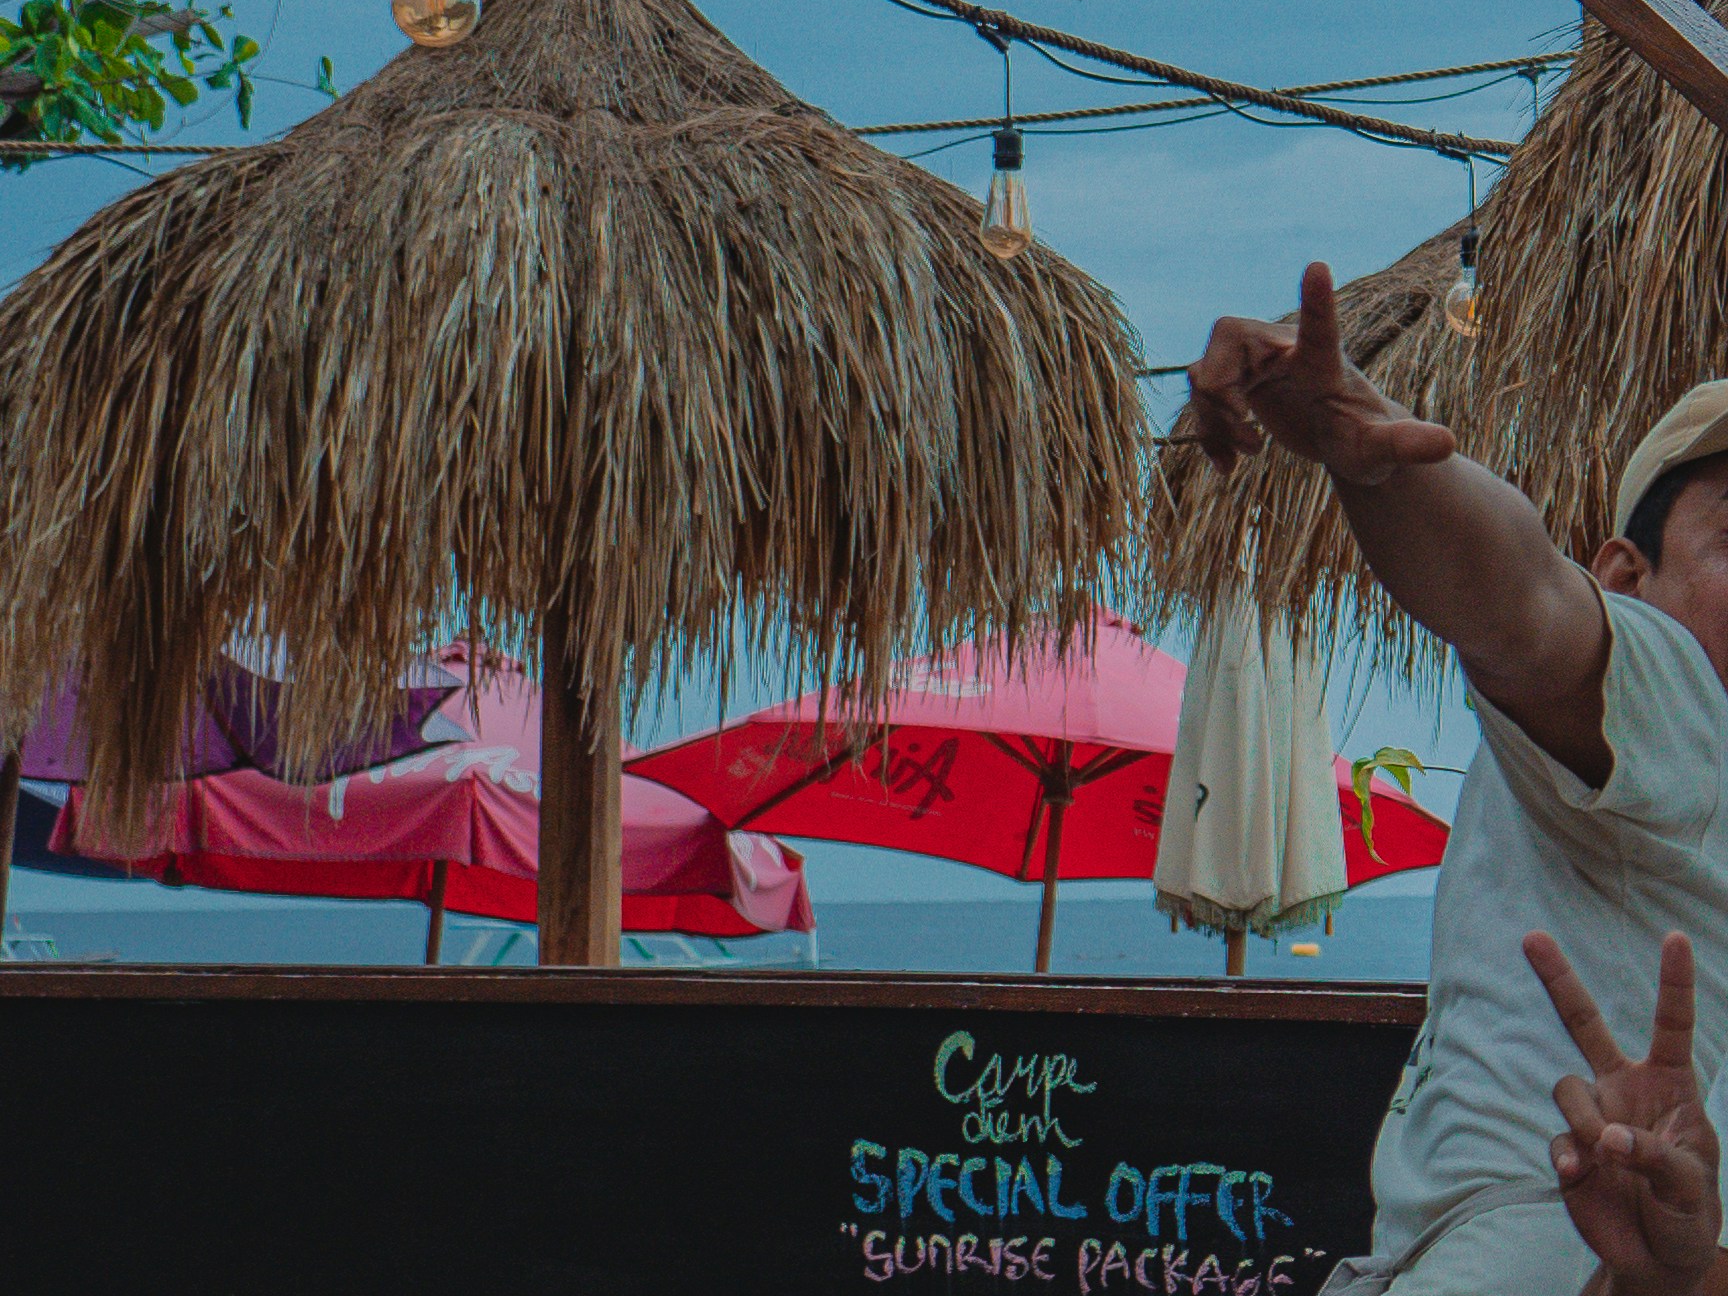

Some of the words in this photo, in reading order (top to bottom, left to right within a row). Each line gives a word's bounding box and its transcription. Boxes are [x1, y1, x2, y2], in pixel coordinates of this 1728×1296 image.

[933, 1030, 1098, 1122] Carpe
[961, 1098, 1084, 1148] diem
[850, 1138, 1088, 1222] SPECIAL
[1105, 1161, 1295, 1241] OFFER
